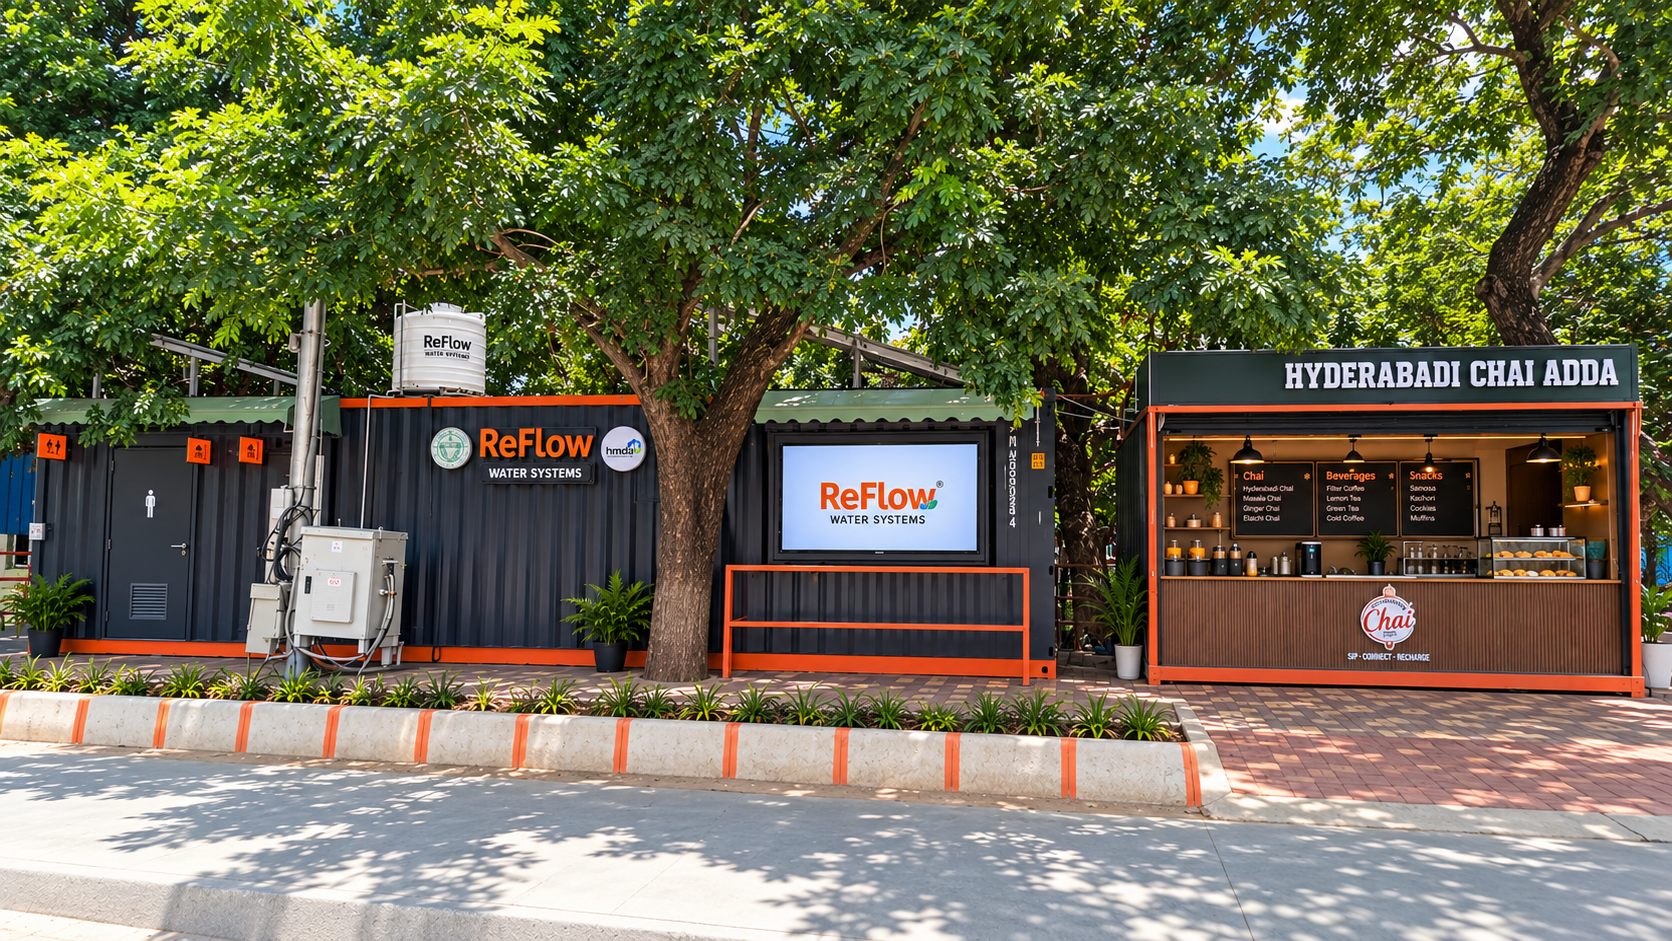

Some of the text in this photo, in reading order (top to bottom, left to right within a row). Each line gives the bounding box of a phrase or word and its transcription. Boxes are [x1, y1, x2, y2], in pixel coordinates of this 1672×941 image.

[424, 335, 472, 351] ReFlow
[1285, 358, 1620, 390] HYDERABADI CHAI ADDA
[479, 428, 594, 458] ReFlow
[606, 446, 634, 455] hmda
[489, 468, 582, 479] WATER SYSTEMS
[1243, 470, 1264, 481] Chai
[1326, 471, 1376, 483] Beverages
[1409, 470, 1443, 480] Snacks
[820, 481, 937, 511] ReFlow
[830, 515, 926, 525] WATER SYSTEMS
[1363, 607, 1414, 632] Chai
